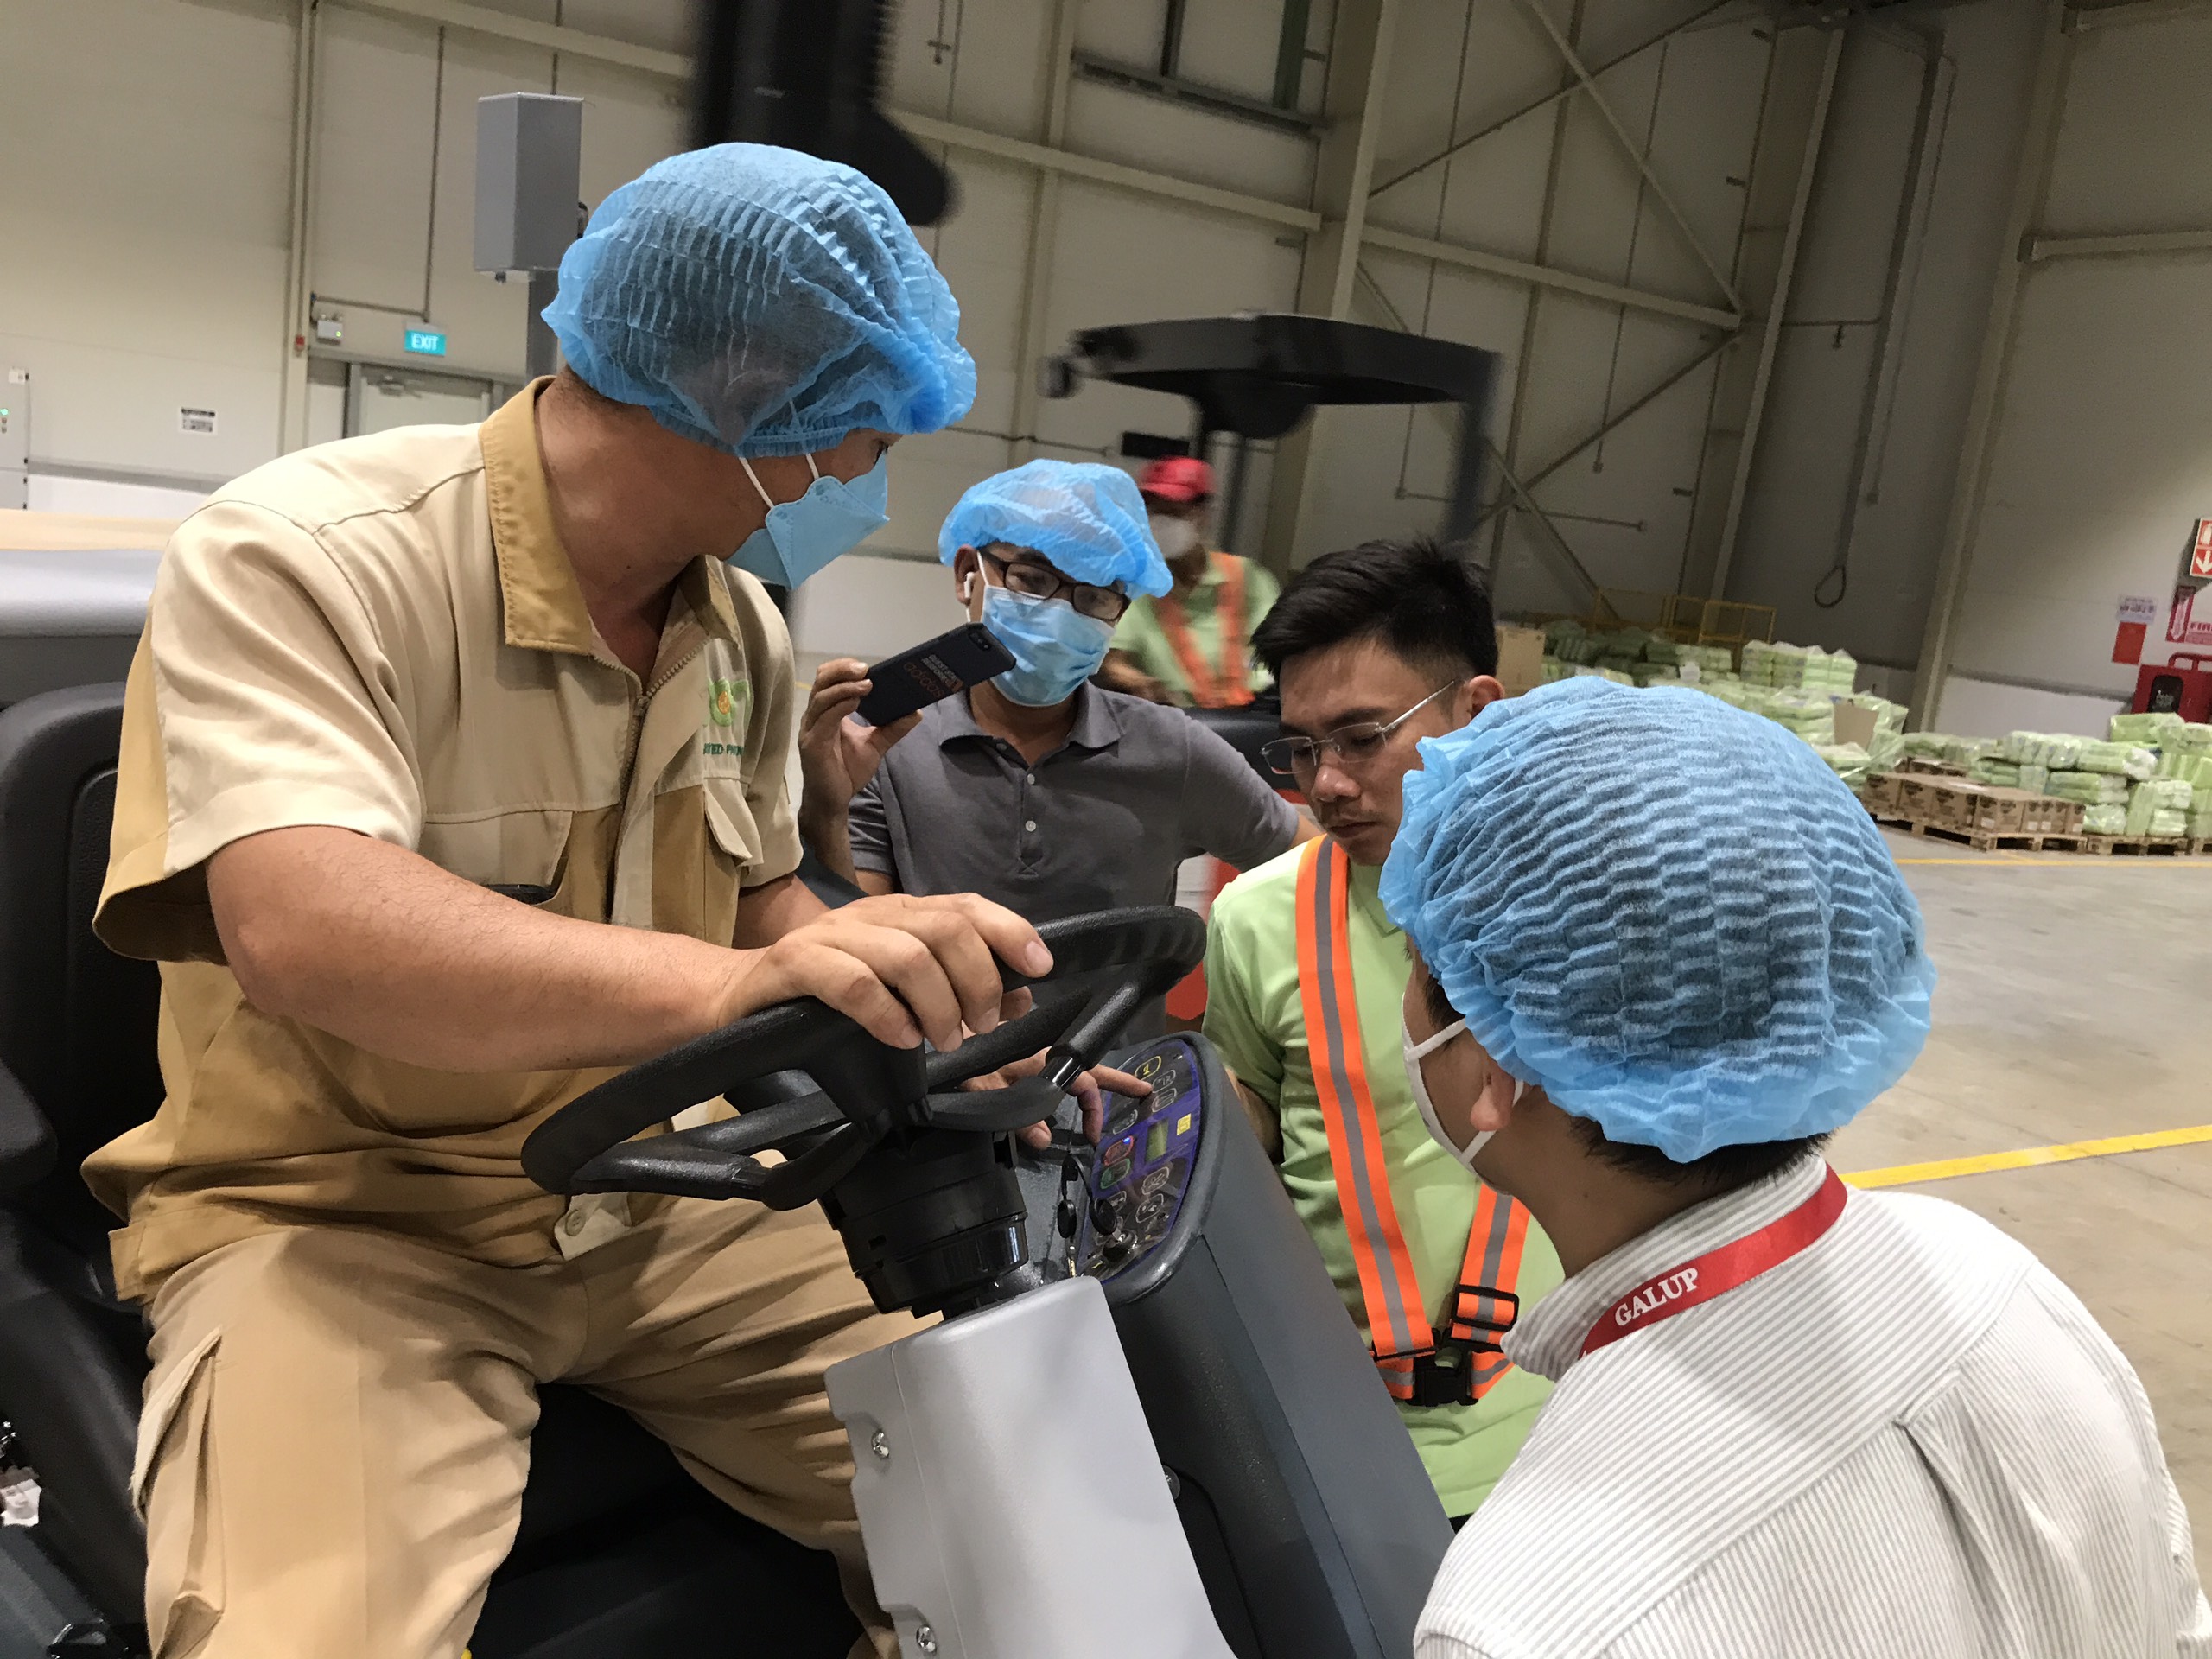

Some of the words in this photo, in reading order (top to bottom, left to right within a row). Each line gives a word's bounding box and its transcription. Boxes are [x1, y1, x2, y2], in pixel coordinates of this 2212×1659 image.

[411, 333, 438, 351] EXIT
[903, 662, 944, 698] adidas
[1615, 1268, 1698, 1326] GALUP
